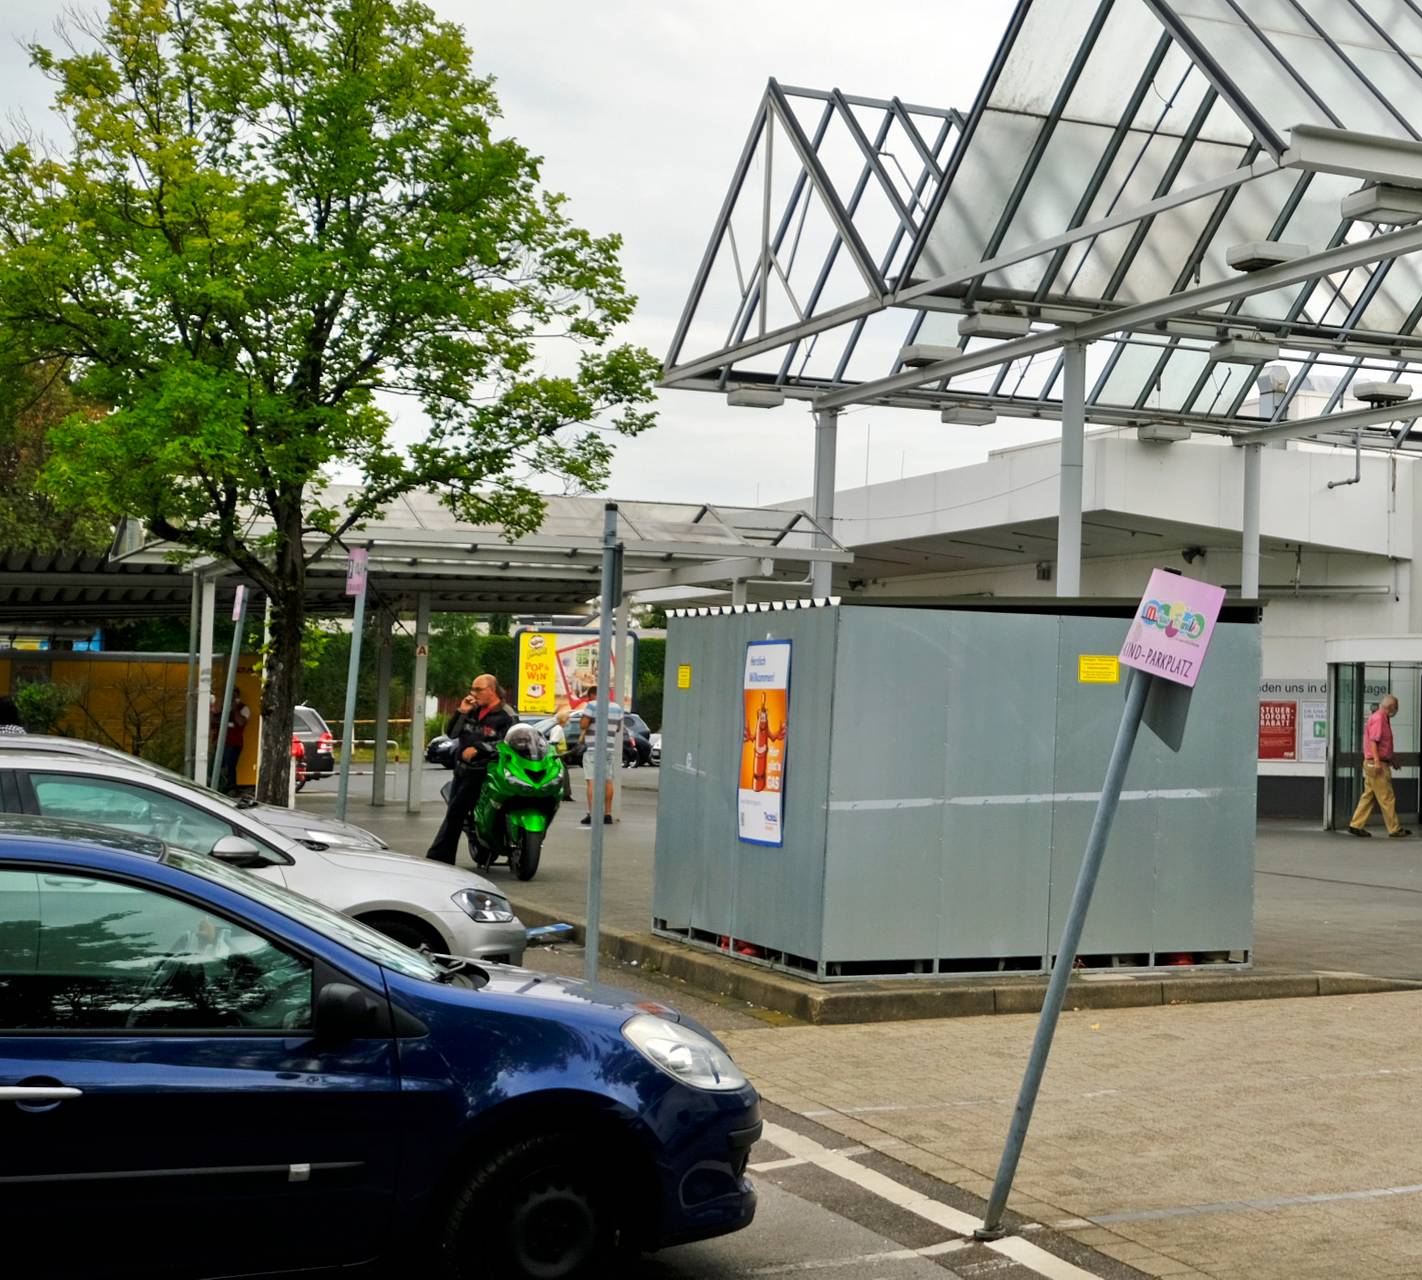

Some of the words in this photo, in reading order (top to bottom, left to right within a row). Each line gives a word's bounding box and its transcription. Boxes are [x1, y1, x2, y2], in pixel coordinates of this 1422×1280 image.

[1124, 642, 1193, 678] IND-PARKPLATZ
[1259, 682, 1282, 694] den
[1285, 683, 1305, 694] uns
[1307, 682, 1317, 693] in
